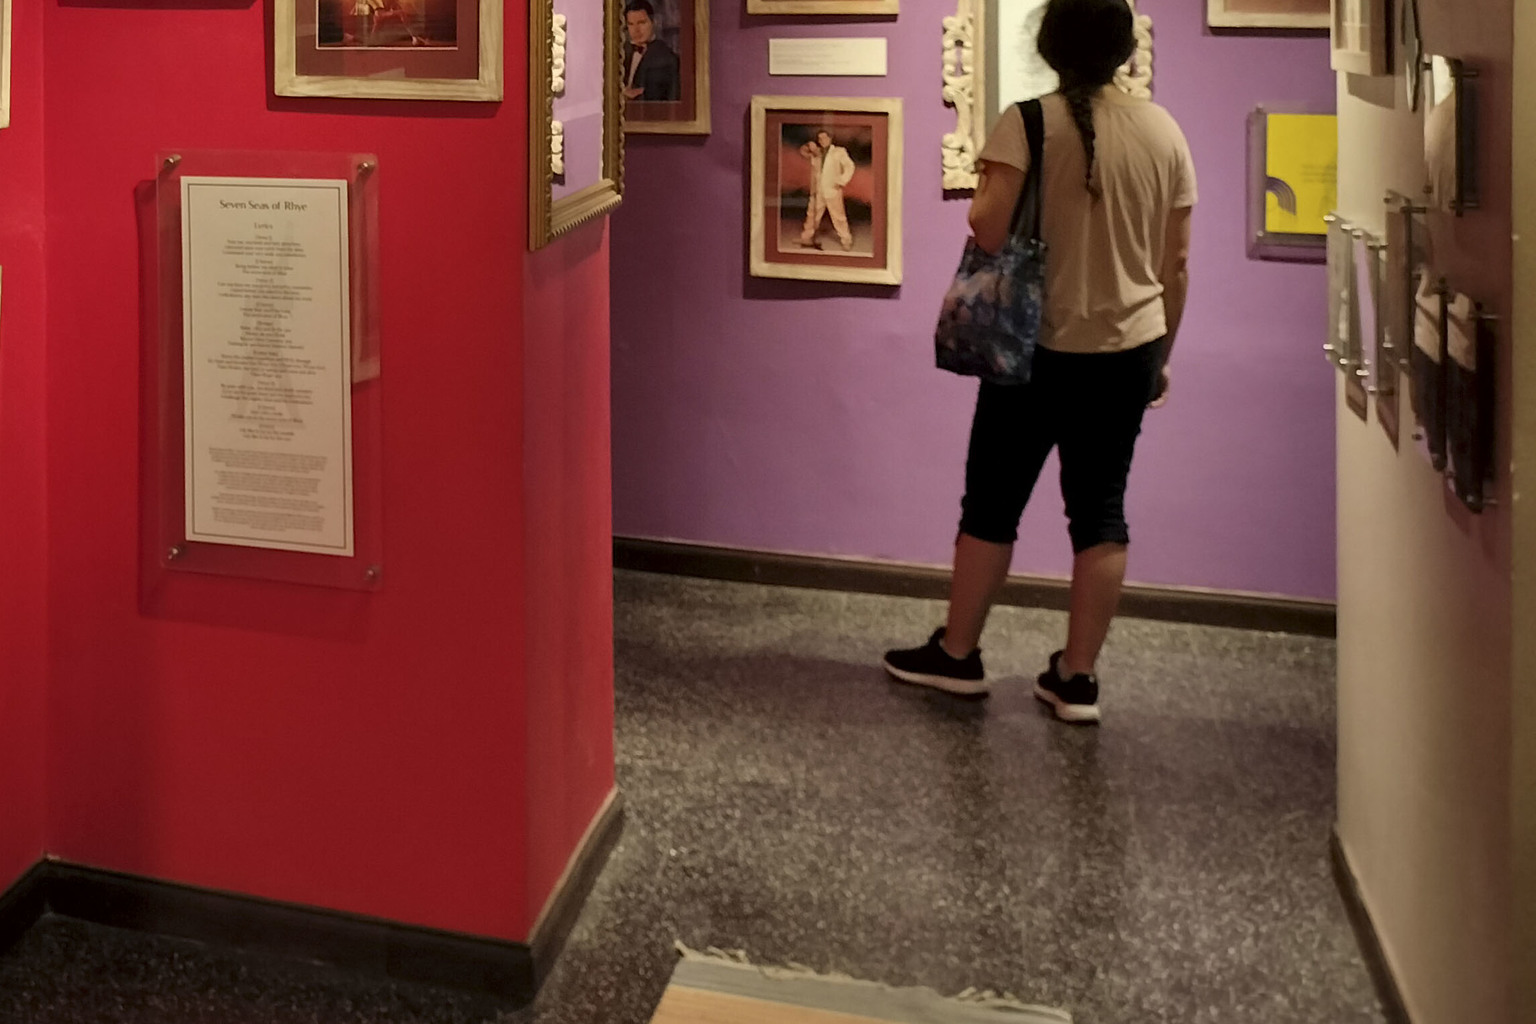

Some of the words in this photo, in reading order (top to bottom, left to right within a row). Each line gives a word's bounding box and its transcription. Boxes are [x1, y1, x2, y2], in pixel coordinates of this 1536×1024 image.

[219, 199, 246, 209] Seven
[248, 200, 269, 210] Seas
[271, 201, 281, 210] of
[284, 201, 307, 212] Rhye
